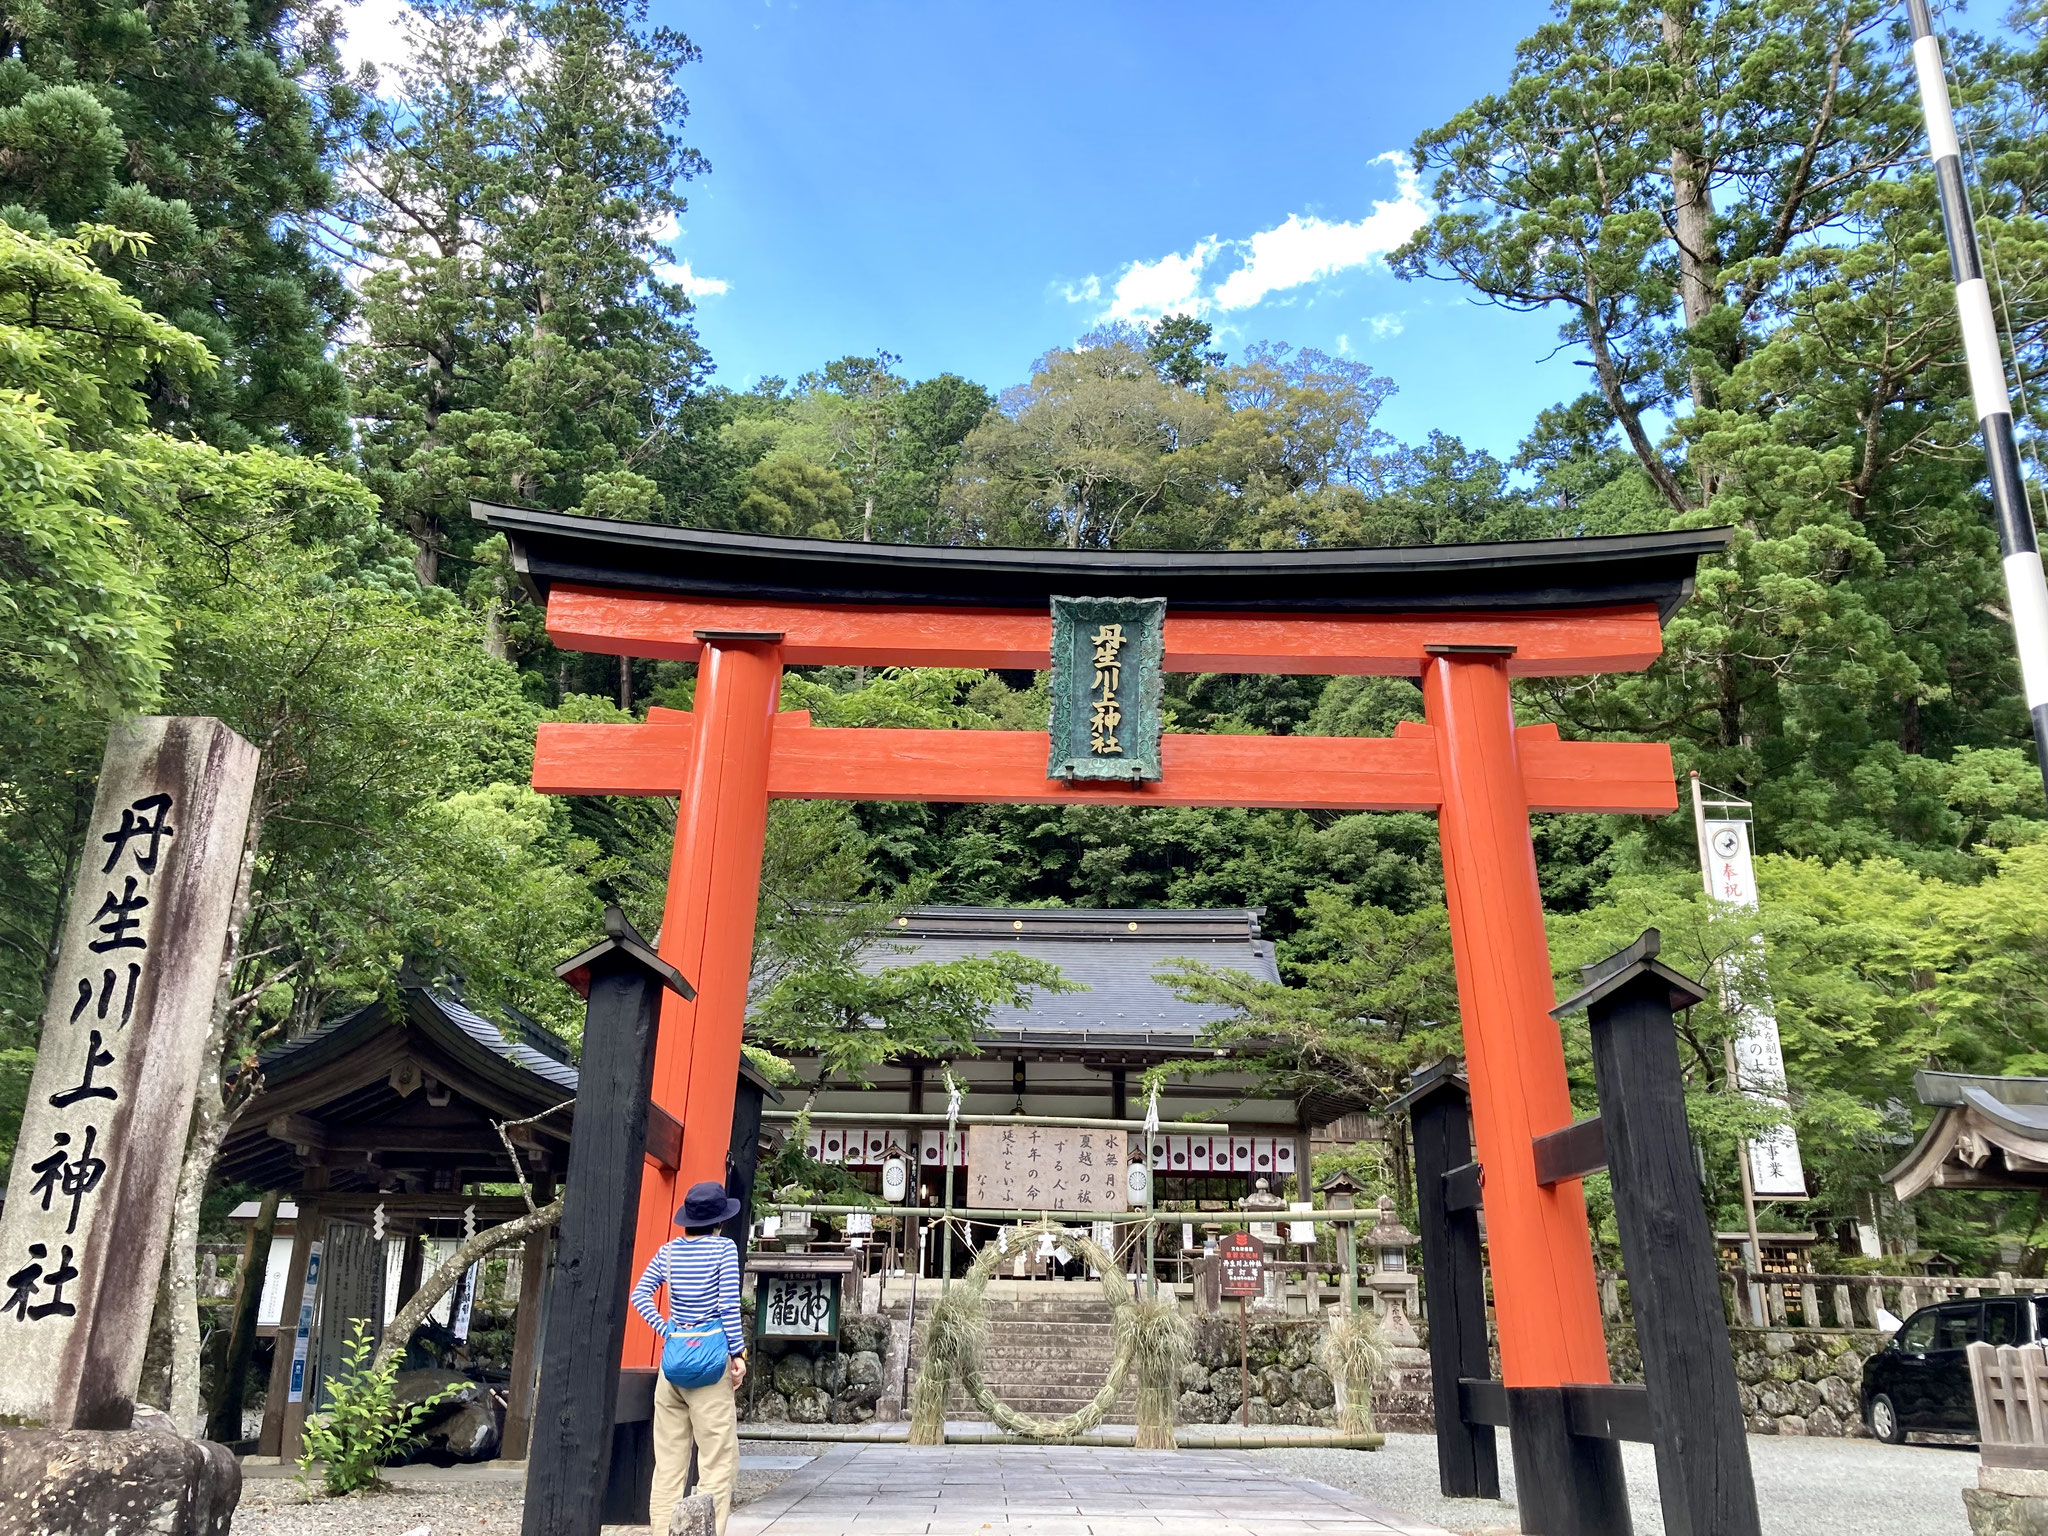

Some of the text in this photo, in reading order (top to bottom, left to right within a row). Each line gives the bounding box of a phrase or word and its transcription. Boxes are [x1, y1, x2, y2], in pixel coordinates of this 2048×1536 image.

[1090, 623, 1127, 754] 丹生川上神社
[1723, 863, 1742, 898] 奉祝
[2, 793, 174, 1322] 丹生川上神社
[977, 1174, 988, 1200] なり
[1002, 1129, 1016, 1202] 延ぶといふ
[1026, 1131, 1041, 1201] 千年の命
[1053, 1139, 1068, 1209] する人は
[1077, 1134, 1093, 1204] 夏越の祓
[1104, 1134, 1119, 1200] 水無月の
[769, 1280, 830, 1332] 龍神
